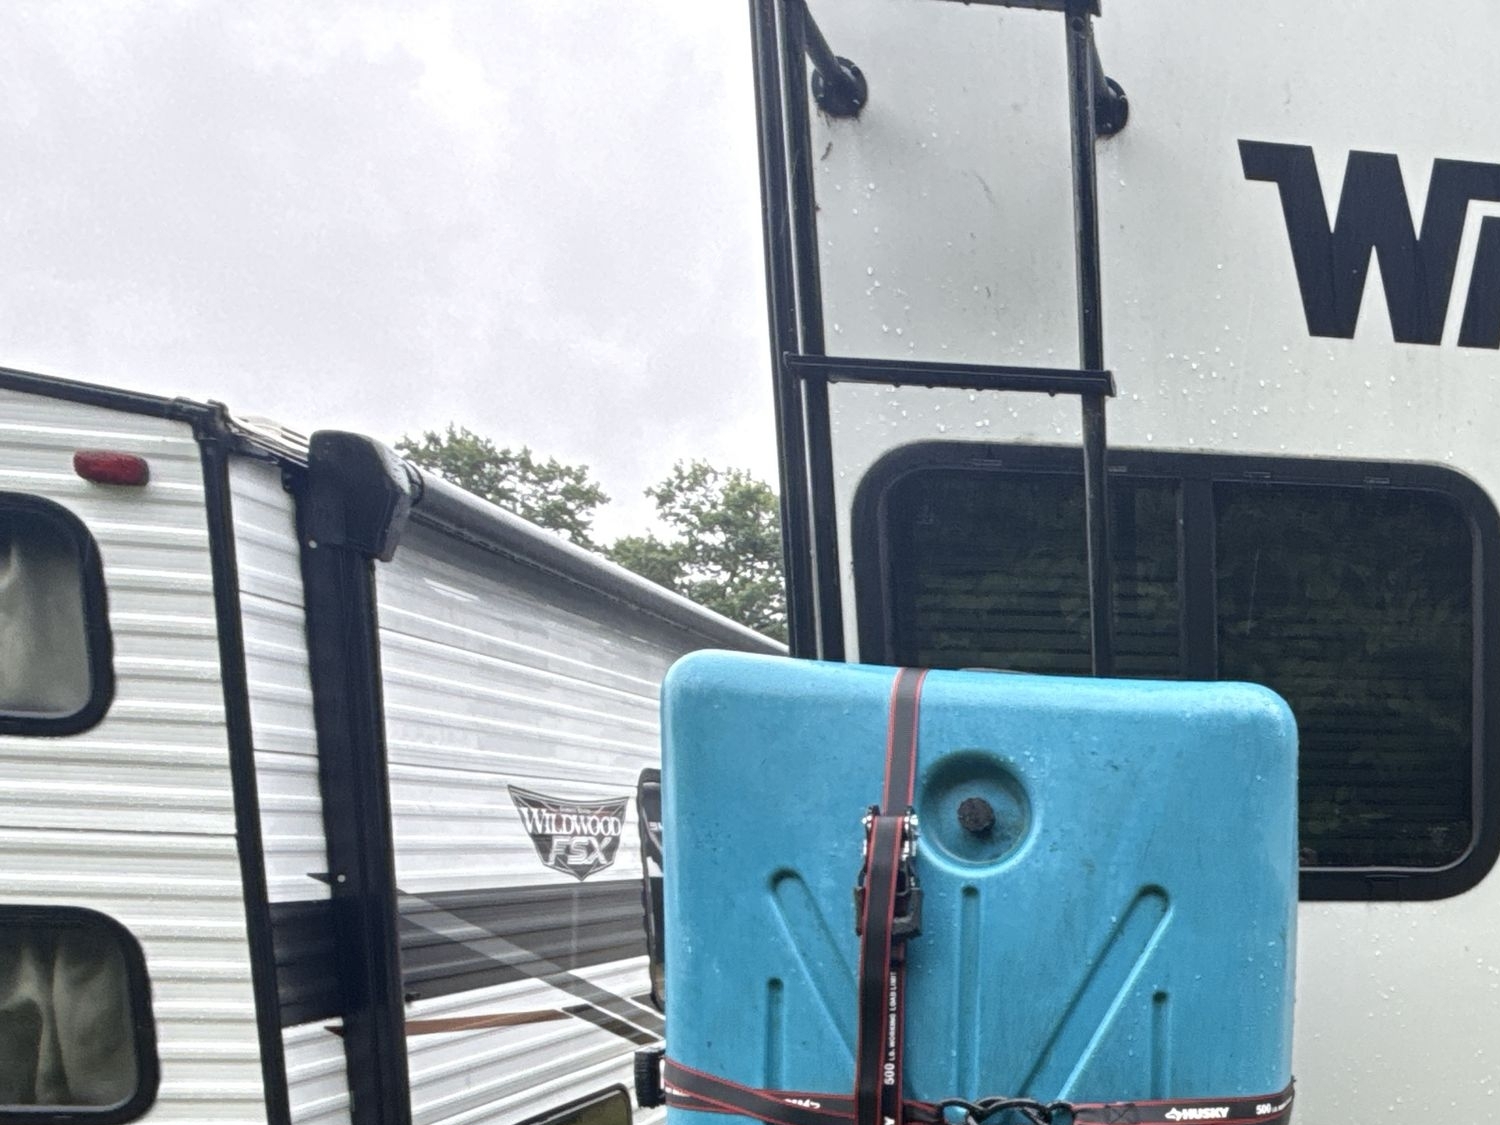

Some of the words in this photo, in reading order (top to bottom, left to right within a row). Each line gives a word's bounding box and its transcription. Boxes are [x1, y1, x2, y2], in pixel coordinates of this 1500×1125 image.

[519, 807, 621, 836] WILDWOOD
[549, 836, 612, 865] FSX
[884, 1062, 895, 1086] 500
[1181, 1107, 1230, 1120] HUSKY
[1255, 1103, 1272, 1115] 500
